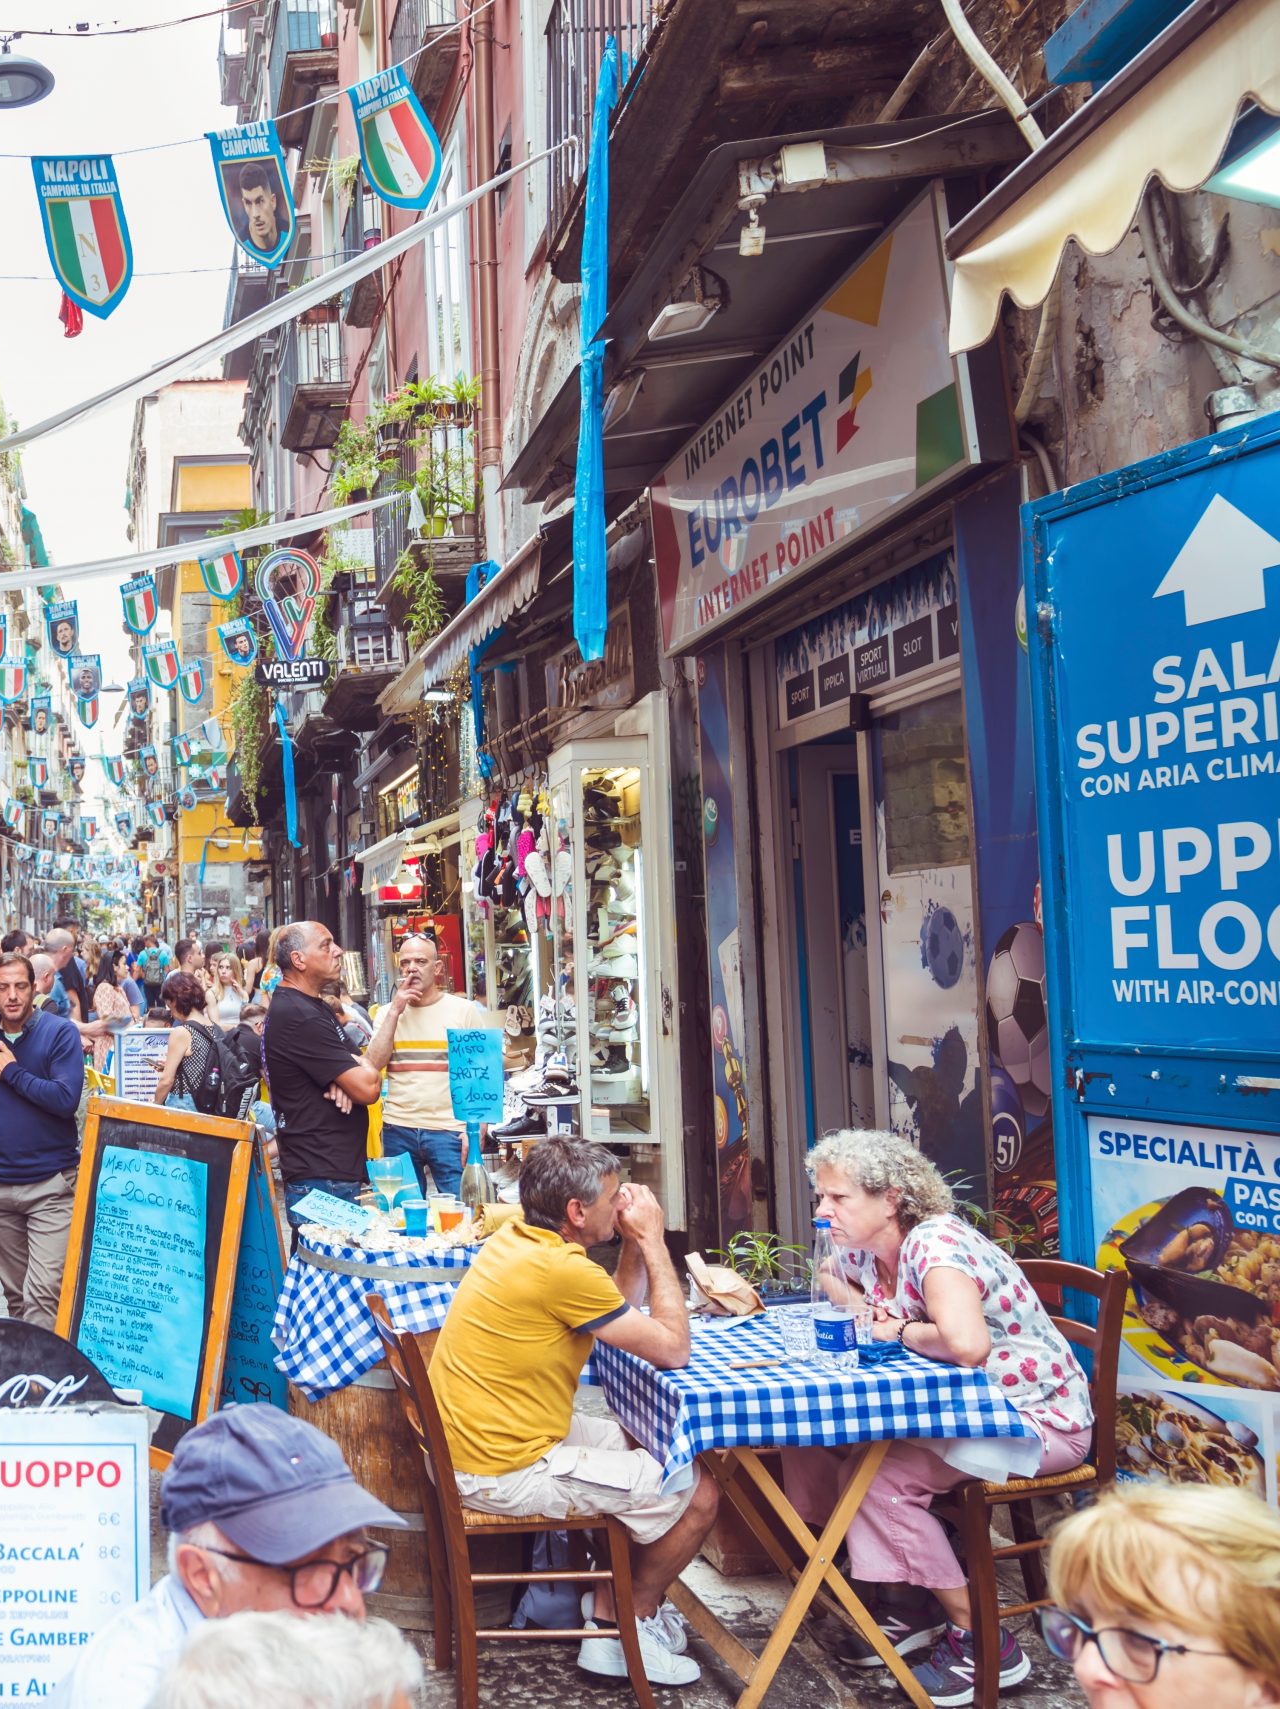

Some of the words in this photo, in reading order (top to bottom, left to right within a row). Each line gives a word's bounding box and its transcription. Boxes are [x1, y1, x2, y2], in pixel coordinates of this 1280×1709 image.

[356, 71, 400, 104] NAPOLI
[357, 98, 382, 119] CAMPIONE
[389, 85, 410, 103] ITALIA
[217, 121, 270, 141] NAPOLI
[221, 137, 270, 157] CAMPIONE
[42, 159, 109, 183] NAPOLI
[40, 184, 80, 197] CAMPIONE
[81, 184, 90, 195] IN
[91, 181, 117, 195] ITALIA
[90, 273, 101, 292] 3
[684, 388, 754, 481] INTERNET
[759, 322, 815, 405] POINT
[687, 390, 828, 569] EUROBET
[698, 551, 770, 626] INTERNET
[776, 505, 837, 575] POINT
[123, 576, 151, 592] NAPOLI
[48, 600, 75, 613] NAPOLI
[860, 645, 883, 667] SPORT
[903, 636, 923, 657] SLOT
[262, 661, 324, 680] VALENTI
[856, 661, 888, 684] VIRTUALI
[823, 671, 845, 692] IPPICA
[791, 686, 810, 704] SPORT
[1080, 771, 1131, 798] CON
[1137, 762, 1201, 791] ARIA
[1107, 817, 1280, 896] UPP
[1111, 900, 1280, 970] FLO
[1112, 979, 1170, 1003] WITH
[1176, 979, 1280, 1006] AIR-CON
[448, 1031, 487, 1043] CUOPPO
[452, 1045, 484, 1057] MISTO
[449, 1066, 490, 1081] SPRITZ
[996, 1135, 1015, 1166] 51
[1098, 1130, 1265, 1176] SPECIALITÀ
[145, 1162, 168, 1176] DEL
[101, 1176, 118, 1203] €
[1235, 1211, 1268, 1228] con
